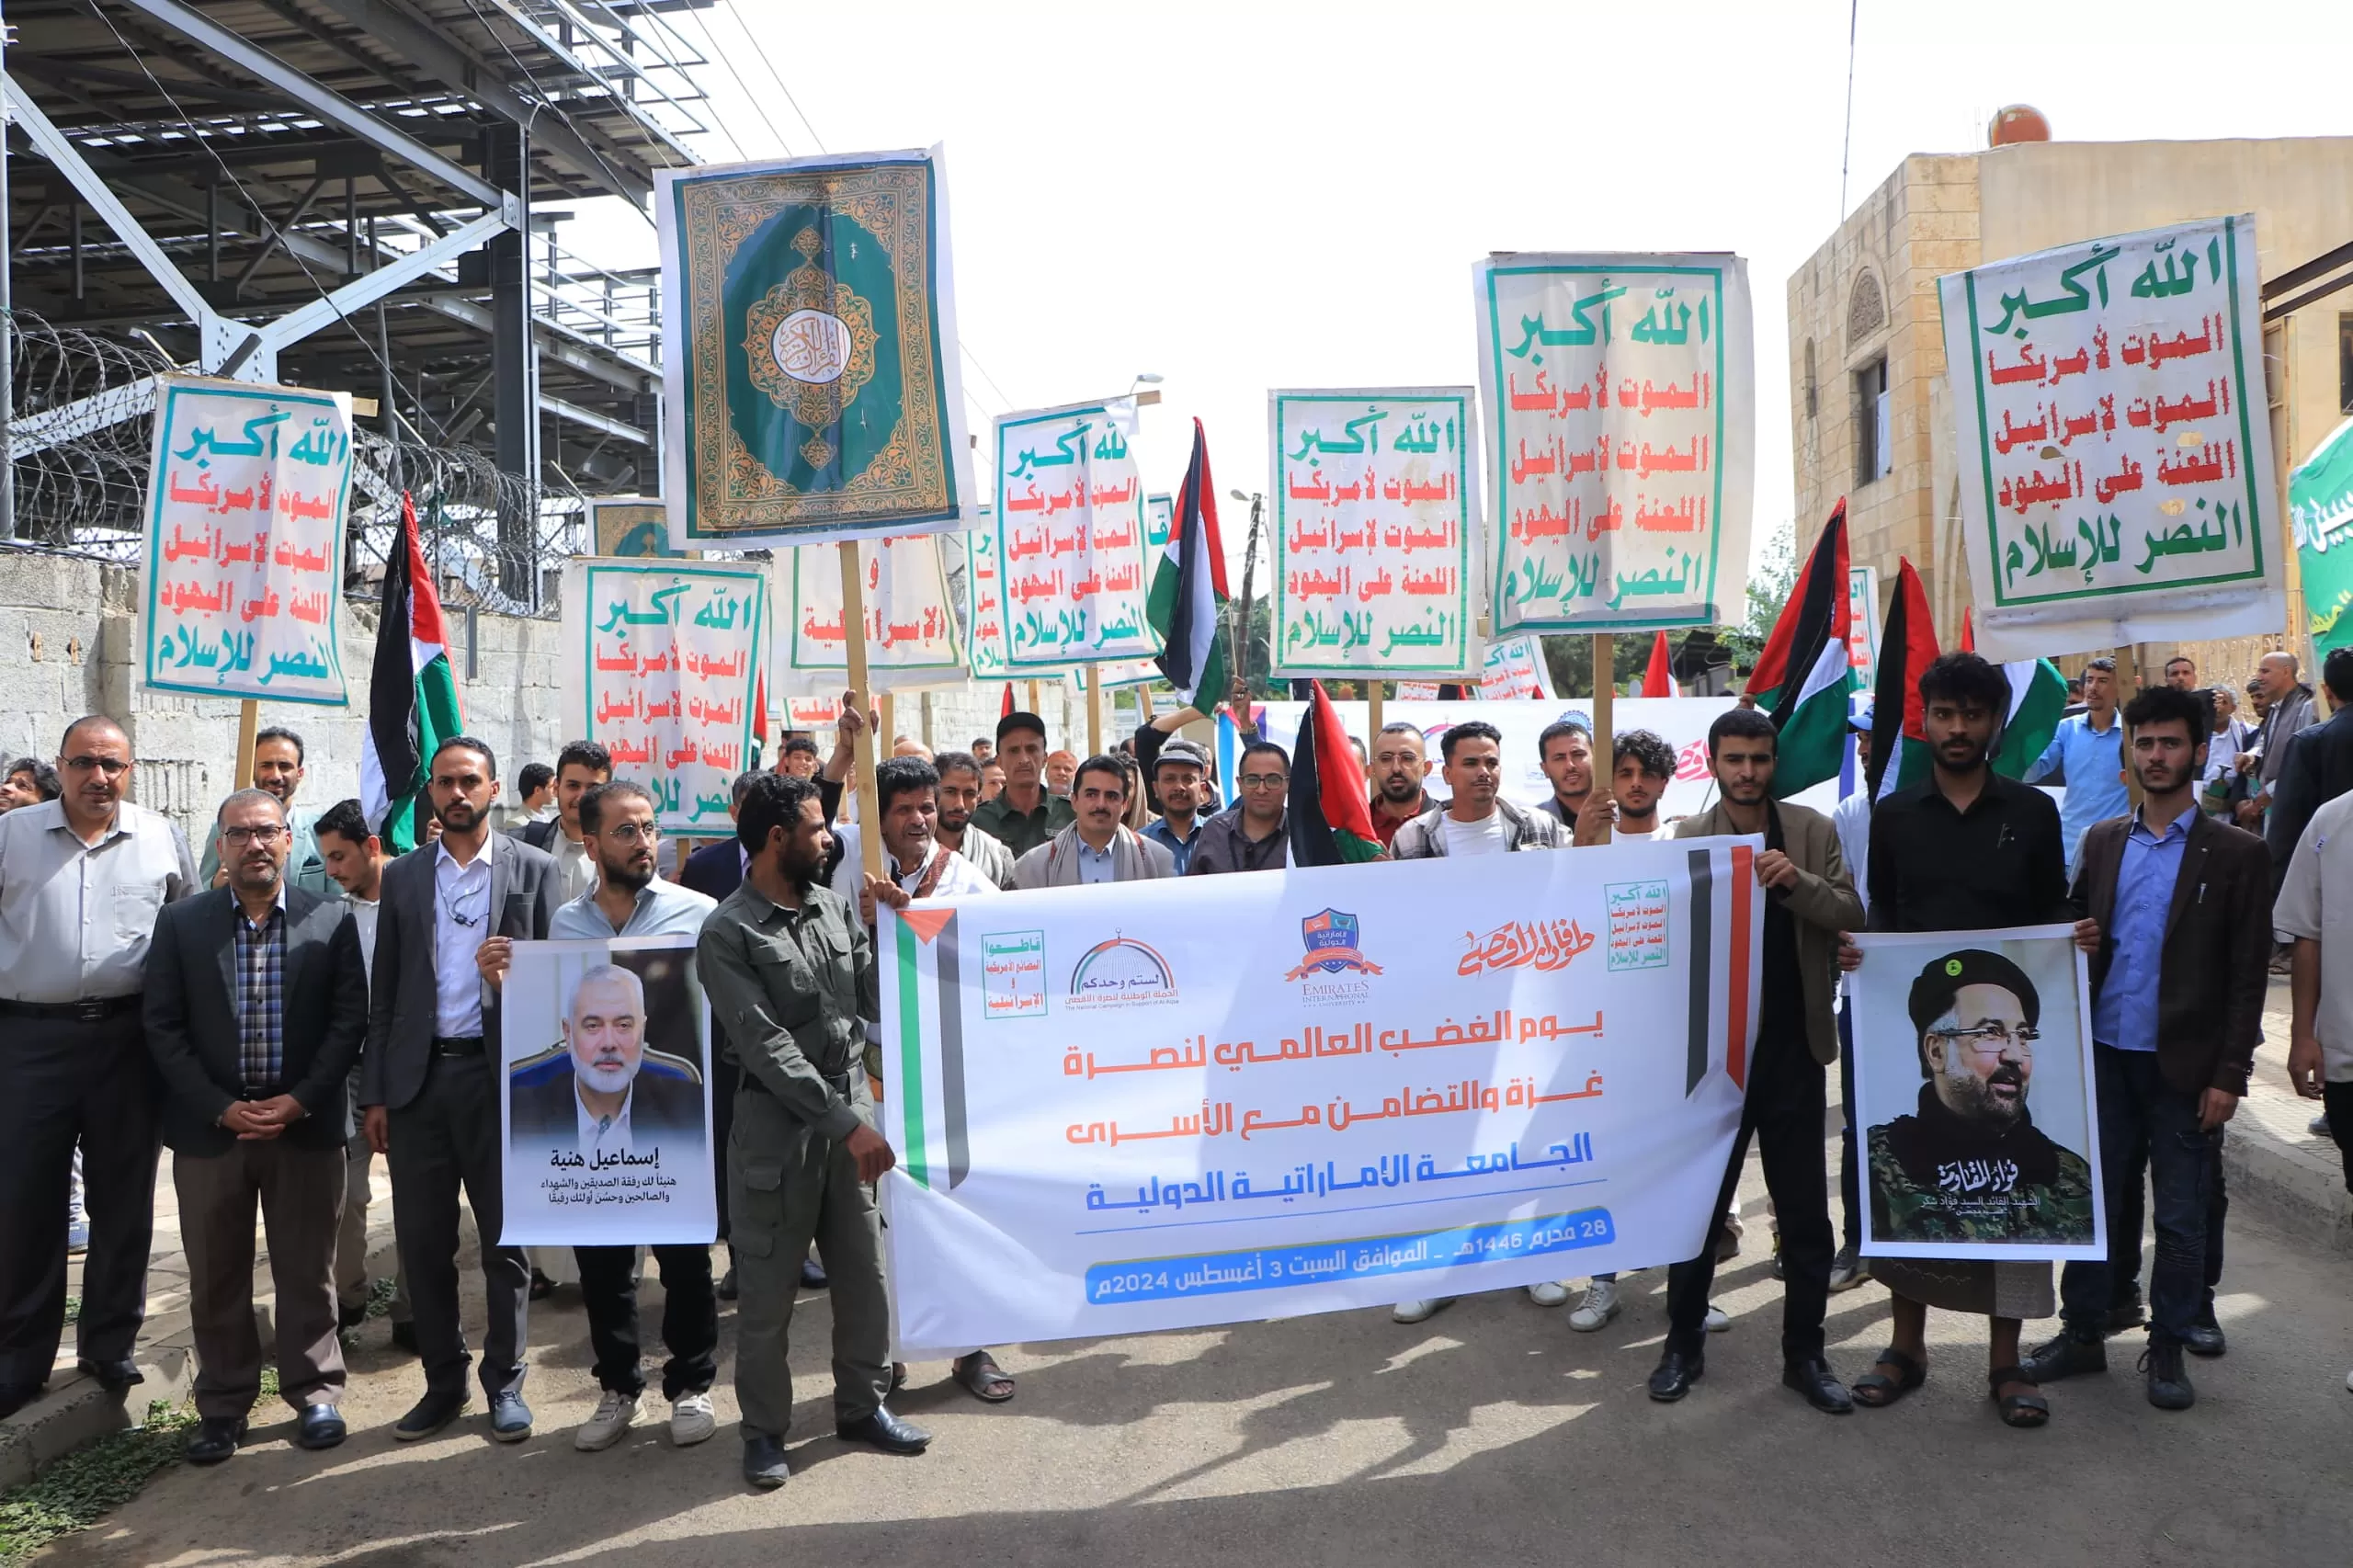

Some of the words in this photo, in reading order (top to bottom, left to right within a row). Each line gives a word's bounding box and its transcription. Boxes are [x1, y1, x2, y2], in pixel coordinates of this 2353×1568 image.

[2131, 235, 2221, 298] الله
[1984, 244, 2121, 340] أكبر
[1506, 278, 1628, 366] أكبر
[1631, 287, 1710, 345] الله
[1988, 324, 2110, 388] لأمريكا
[2121, 311, 2223, 369] الموت
[1509, 361, 1609, 420] لأمريكا
[1618, 370, 1710, 418] الموت
[2127, 376, 2230, 434] الموت
[173, 404, 291, 469] أكبر
[289, 417, 347, 466] الله
[1094, 423, 1127, 459] لله
[1287, 405, 1388, 467] أكبر
[1393, 412, 1455, 453] الله
[1995, 392, 2116, 455] لإسرائيل
[1007, 419, 1092, 481] أكبر
[1512, 434, 1610, 485] لإسرائيل
[1617, 434, 1709, 480] الموت
[2157, 438, 2235, 485] اللعنة
[170, 471, 272, 515] لأمريكا
[1008, 475, 1085, 516] لأمريكا
[1290, 464, 1376, 507] لأمريكا
[1383, 471, 1455, 506] الموت
[1998, 459, 2084, 515] اليهود
[2096, 453, 2143, 505] على
[1510, 496, 1580, 546] اليهود
[1587, 493, 1622, 542] على
[1635, 493, 1706, 533] اللعنة
[165, 523, 268, 573] لإسرائيل
[1009, 524, 1086, 562] لإسرائيل
[1290, 517, 1376, 555] لإسرائيل
[1384, 519, 1456, 554] الموت
[2006, 512, 2121, 589] للإسلام
[2133, 496, 2243, 574] النصر
[869, 558, 879, 589] و
[1010, 568, 1063, 604] اليهود
[1071, 566, 1101, 601] على
[1106, 562, 1139, 591] اللعنة
[1289, 565, 1350, 602] اليهود
[1358, 566, 1392, 602] على
[1402, 564, 1455, 596] اللعنة
[1505, 551, 1599, 618] للإسلام
[1607, 545, 1701, 611] النصر
[161, 580, 233, 618] اليهود
[240, 585, 279, 622] على
[596, 577, 691, 638] أكبر
[694, 586, 751, 631] الله
[804, 606, 945, 648] الإسرائلية
[1015, 608, 1086, 656] للإسلام
[1092, 601, 1146, 650] النصر
[1288, 609, 1372, 658] للإسلام
[1379, 606, 1454, 657] النصر
[159, 623, 254, 685] للإسلام
[257, 634, 336, 685] النصر
[596, 637, 680, 677] لأمريكا
[686, 649, 745, 681] الموت
[597, 686, 681, 725] لإسرائيل
[689, 695, 741, 727] الموت
[666, 736, 697, 769] على
[702, 737, 738, 771] اللعنة
[1610, 883, 1642, 905] أكبر
[1643, 904, 1665, 916] الموت
[1645, 885, 1665, 898] الله
[1610, 904, 1640, 919] لأمريكا
[1612, 922, 1640, 935] لإسرائيل
[1642, 919, 1665, 930] الموت
[985, 937, 1040, 957] قاطعوا
[1082, 976, 1125, 991] وحدكم
[1121, 991, 1150, 1000] الوطنية
[1128, 974, 1161, 990] لستم
[1154, 989, 1177, 998] الحملة
[1302, 992, 1369, 1003] INTERNATIONAL
[988, 993, 1043, 1011] الإسرائيلية
[1380, 1010, 1511, 1058] الغضب
[1519, 1011, 1603, 1044] يوم
[1063, 1035, 1207, 1080] لنصرة
[1214, 1022, 1372, 1073] العالمي
[1327, 1080, 1499, 1131] والتضامن
[1506, 1070, 1603, 1109] غزة
[1065, 1098, 1233, 1147] الأسرى
[1241, 1105, 1321, 1141] مع
[551, 1148, 585, 1171] هنية
[589, 1147, 660, 1171] إسماعيل
[1416, 1132, 1593, 1182] الجامعة
[541, 1177, 579, 1191] والشهداء
[570, 1189, 593, 1204] أولئك
[580, 1176, 620, 1189] الصديقين
[621, 1176, 641, 1188] رفقة
[625, 1190, 670, 1203] والصالحين
[642, 1176, 654, 1186] لك
[1086, 1170, 1225, 1214] الدولية
[1939, 1196, 1959, 1210] فؤاد
[1960, 1196, 1984, 1208] السيد
[1985, 1196, 2009, 1206] القائد
[2009, 1196, 2040, 1209] الشهيد
[1529, 1226, 1576, 1251] محرم
[1580, 1219, 1608, 1238] 28
[1175, 1252, 1262, 1291] أغسطس
[1268, 1260, 1283, 1278] 3
[1289, 1249, 1347, 1279] السبت
[1353, 1240, 1427, 1272] الموافق
